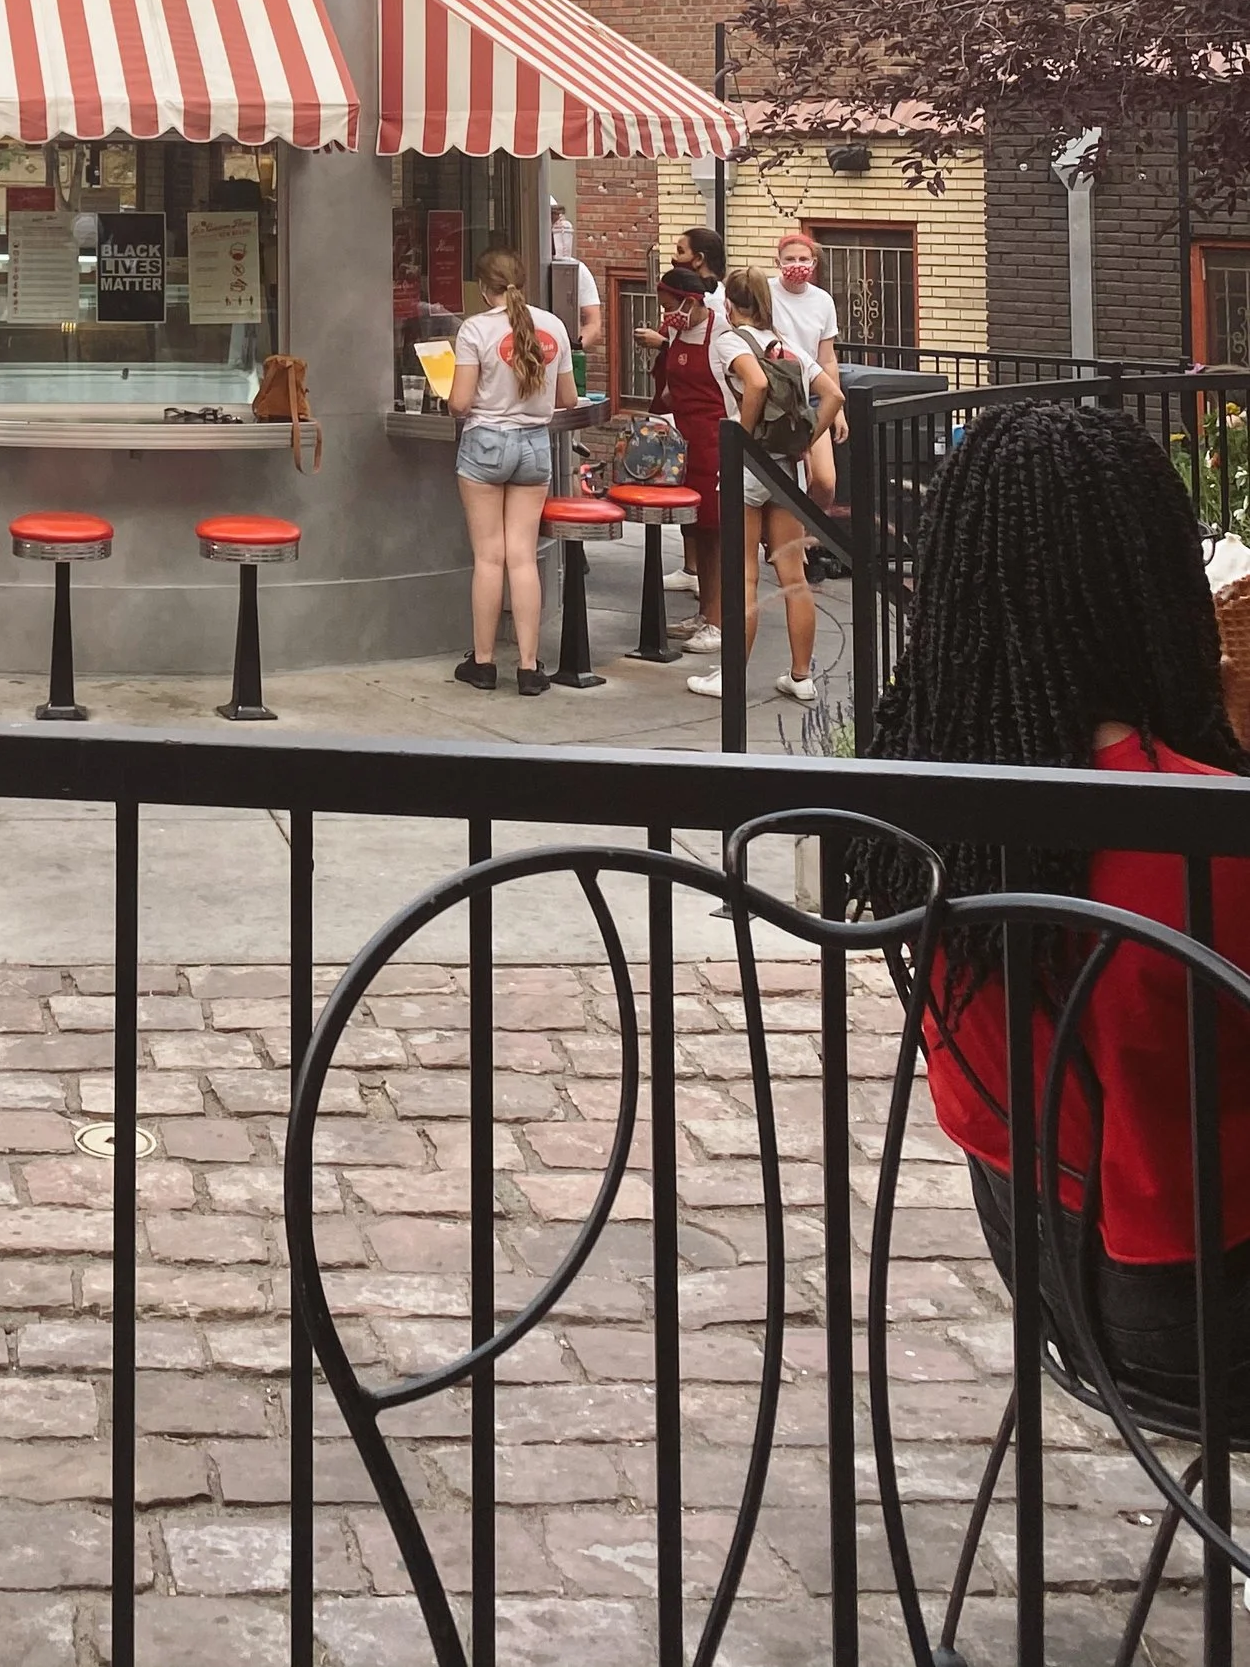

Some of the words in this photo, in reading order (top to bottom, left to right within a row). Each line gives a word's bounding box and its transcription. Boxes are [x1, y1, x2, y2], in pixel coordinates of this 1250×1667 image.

[100, 244, 161, 257] BLACK
[101, 259, 161, 274] LIVES
[100, 277, 162, 291] MATTER
